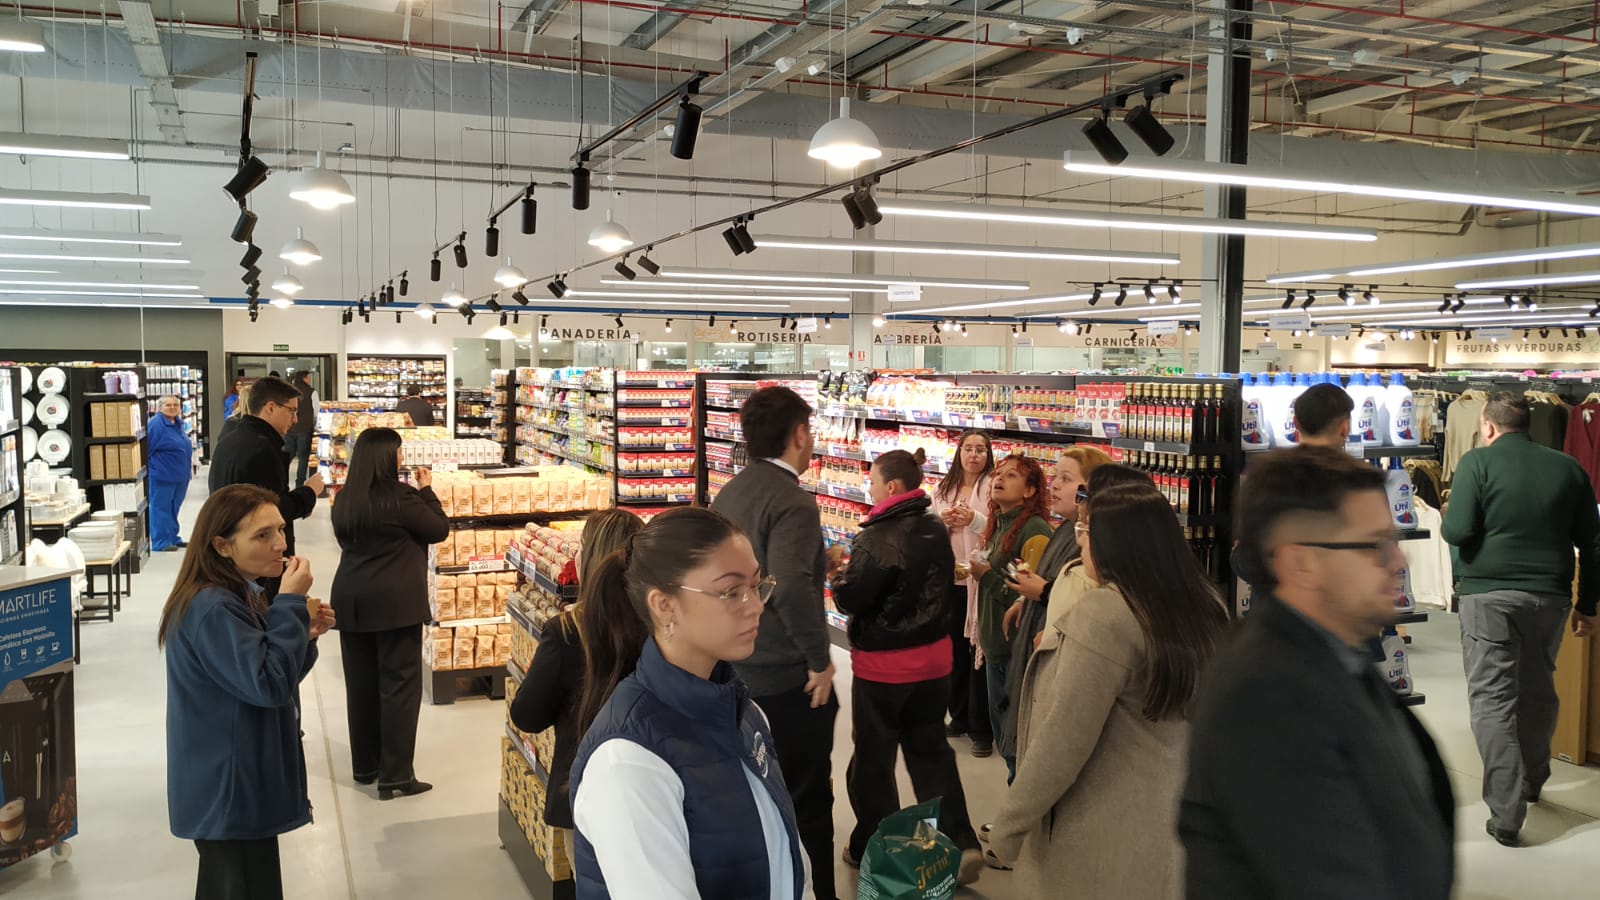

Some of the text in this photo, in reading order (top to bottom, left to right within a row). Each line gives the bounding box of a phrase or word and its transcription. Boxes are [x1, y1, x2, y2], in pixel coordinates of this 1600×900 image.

[1457, 342, 1582, 353] FRUTAS Y VERDURAS
